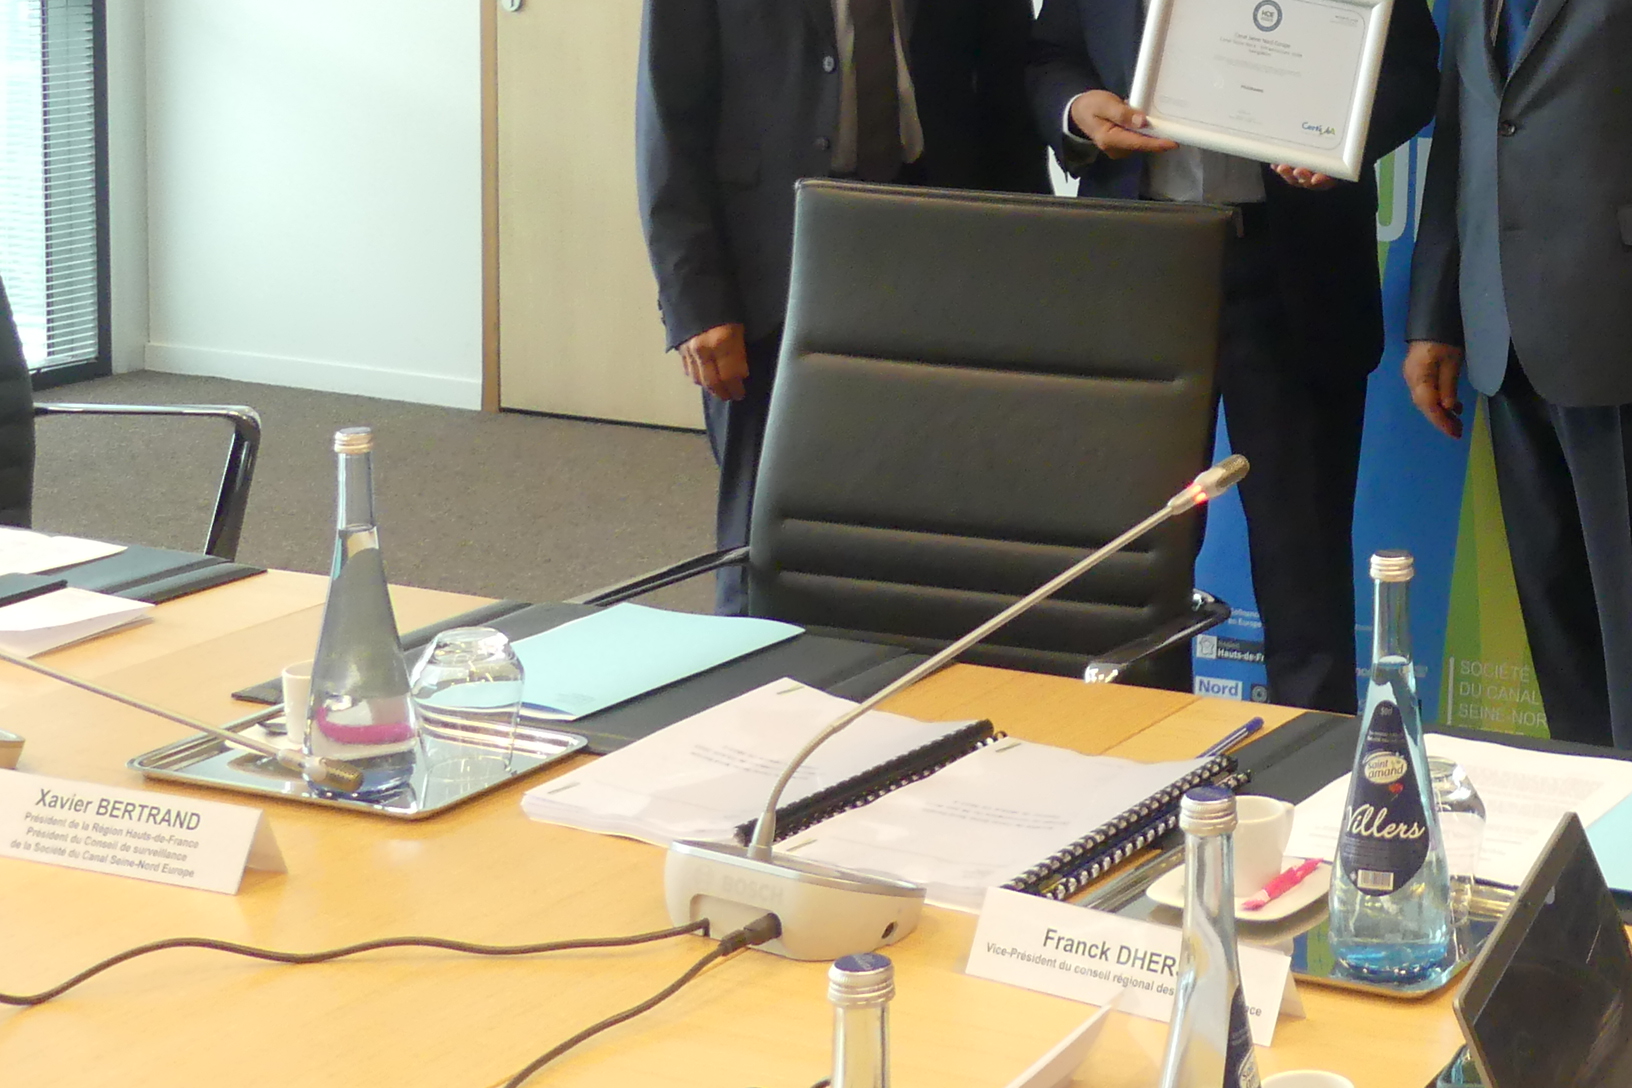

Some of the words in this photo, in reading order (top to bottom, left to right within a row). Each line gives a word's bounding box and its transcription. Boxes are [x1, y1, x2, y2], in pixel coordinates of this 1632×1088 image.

[1217, 648, 1265, 663] Hauts-de-Fr
[1199, 679, 1239, 696] Nord
[1460, 682, 1482, 698] DU
[1486, 685, 1540, 706] CANAL
[1459, 703, 1549, 728] SEINE-NOR
[1368, 765, 1404, 779] amand
[35, 788, 93, 814] Xavier
[96, 798, 201, 831] BERTRAND
[1346, 803, 1425, 840] Villers
[24, 812, 67, 828] Président
[68, 819, 80, 829] de
[81, 821, 90, 831] la
[92, 822, 124, 837] Région
[125, 828, 200, 849] Hauts-de-France
[26, 827, 69, 844] Président
[70, 833, 82, 844] du
[84, 836, 118, 851] Conseil
[119, 842, 131, 853] de
[133, 845, 188, 862] surveillance
[10, 839, 21, 849] de
[23, 841, 32, 851] la
[33, 842, 67, 857] Société
[68, 848, 80, 859] du
[82, 850, 109, 864] Canal
[110, 855, 160, 872] Seine-Nord
[161, 863, 195, 878] Europe
[723, 874, 784, 905] BOSCH
[1043, 928, 1112, 963] Franck
[986, 942, 1057, 969] Vice-Président
[1059, 959, 1072, 973] du
[1074, 963, 1111, 982] conseil
[1113, 972, 1154, 992] régional
[1156, 982, 1175, 997] des
